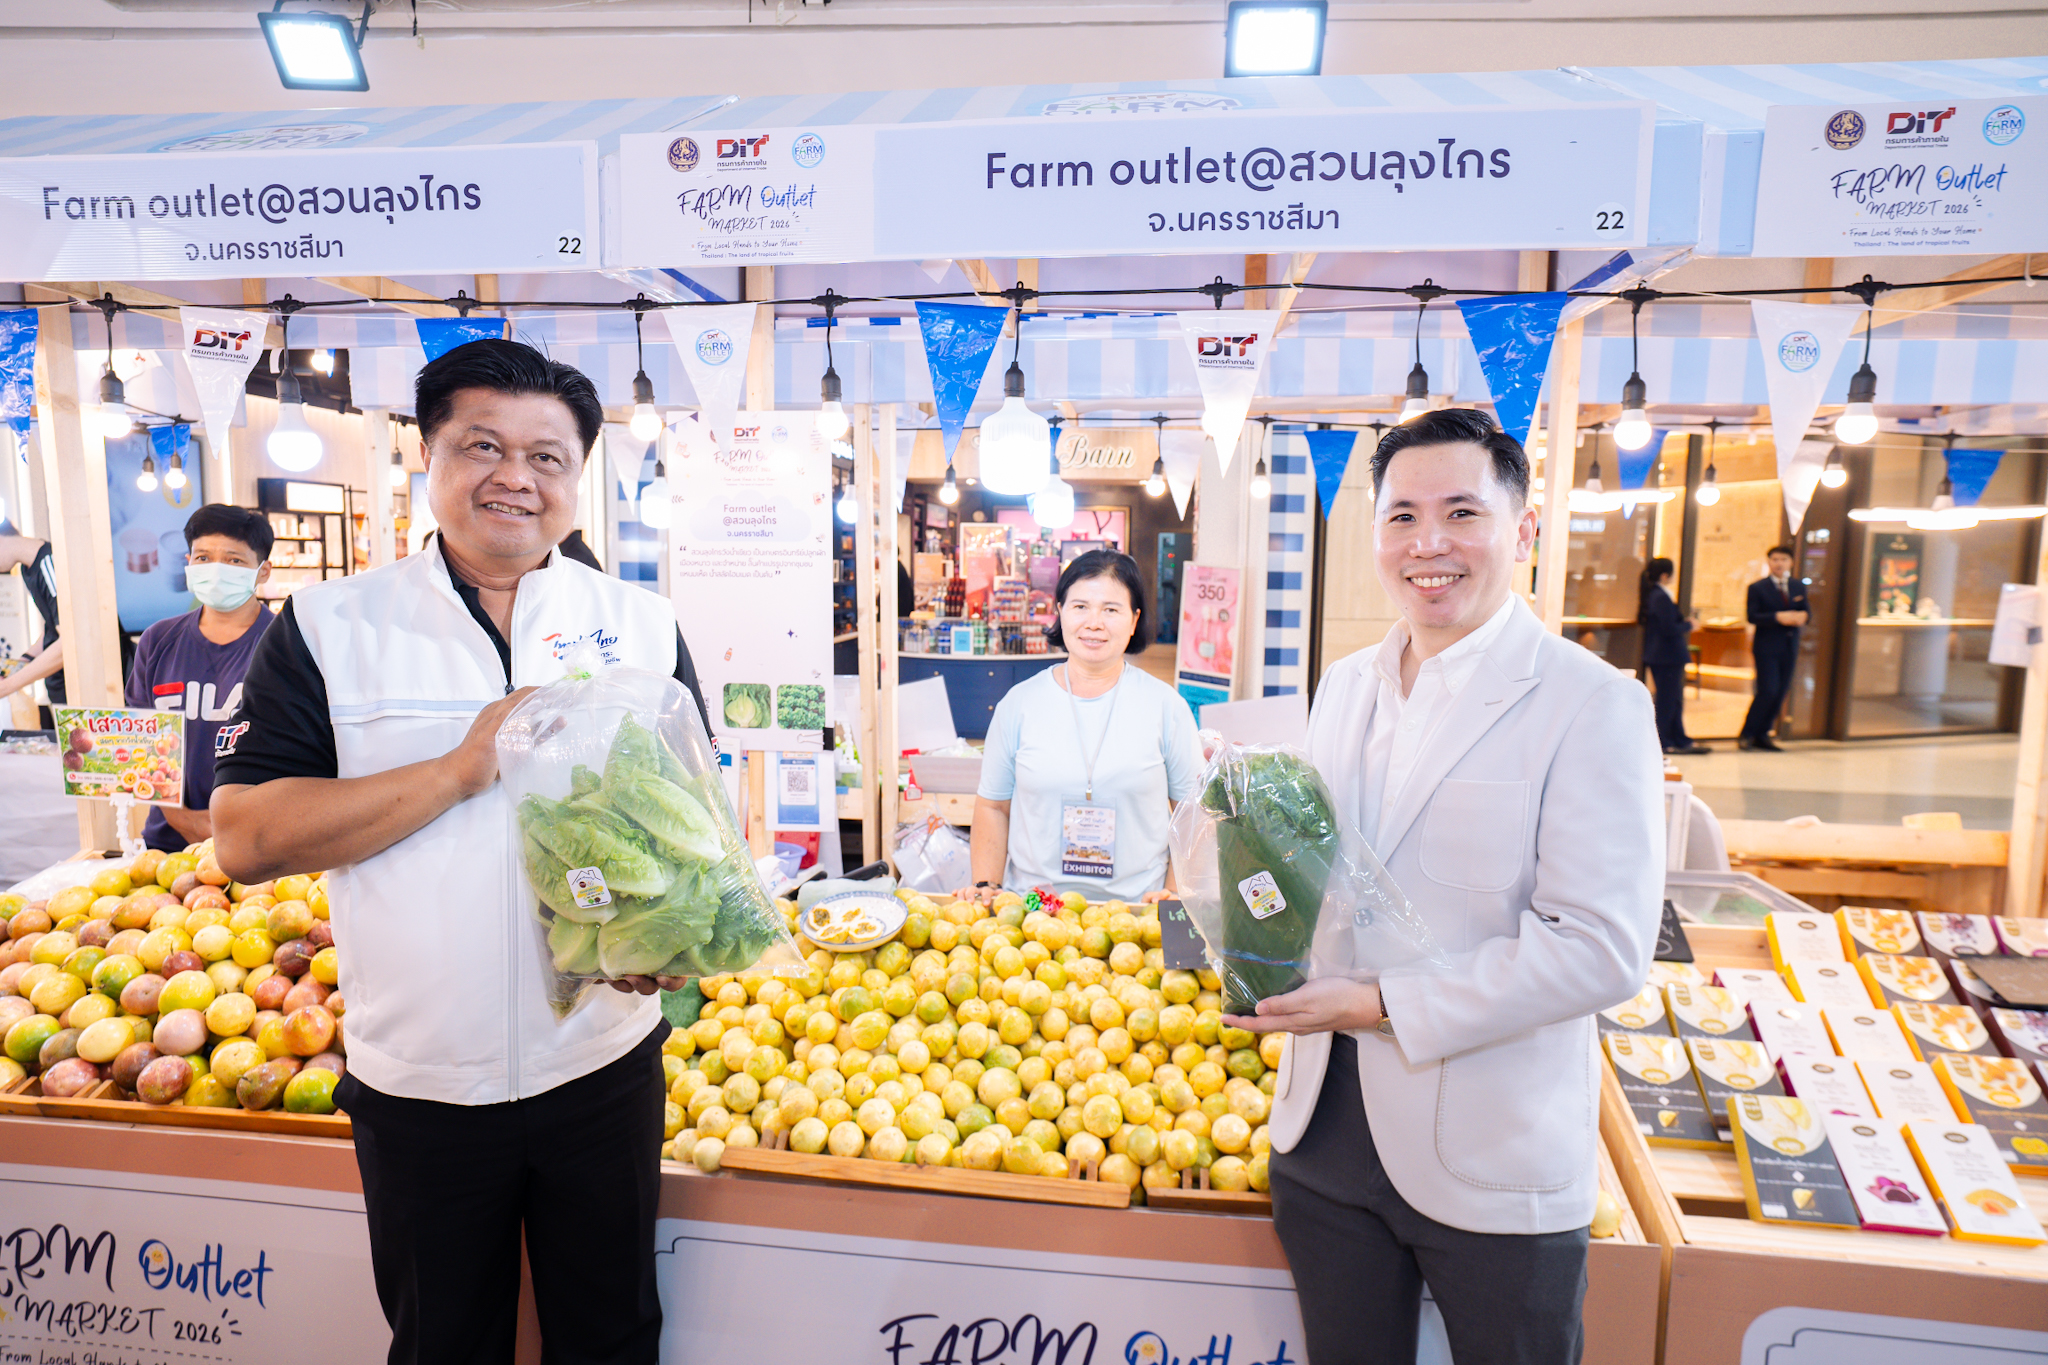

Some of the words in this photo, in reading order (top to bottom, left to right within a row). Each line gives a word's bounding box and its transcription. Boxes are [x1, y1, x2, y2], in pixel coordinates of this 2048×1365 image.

[1986, 119, 2022, 130] FARM
[1986, 128, 2020, 137] OUTLET
[1885, 135, 1949, 145] กรมการค้าภายใน
[794, 145, 823, 155] FARM
[717, 158, 767, 167] กรมการค้าภายใน
[986, 152, 1093, 189] Farm
[1109, 138, 1511, 193] outlet@สวนลุงไกร
[1830, 163, 1926, 204] FARM
[1936, 163, 2008, 192] Outlet
[43, 186, 136, 220] Farm
[149, 174, 481, 224] outlet@สวนลุงไกร
[677, 184, 752, 220] FARM
[760, 183, 817, 210] Outlet
[1866, 200, 1943, 220] MARKET
[1944, 204, 1969, 214] 2026
[1148, 202, 1340, 232] จ.นครราชสีมา
[1596, 211, 1625, 231] 22
[708, 215, 768, 234] MARKET
[770, 220, 790, 229] 2026
[1849, 227, 1868, 237] From
[1870, 226, 1891, 237] Local
[1894, 225, 1918, 236] Hands
[1921, 226, 1928, 236] to
[1931, 225, 1951, 236] Your
[1954, 224, 1976, 235] Home
[184, 234, 343, 261] จ.นครราชสีมา
[557, 237, 581, 255] 22
[697, 241, 712, 249] From
[714, 241, 731, 249] Local
[699, 342, 731, 351] FARM
[1781, 345, 1817, 356] FARM
[191, 348, 249, 360] กรมการค้าภายใน
[1781, 354, 1816, 362] OUTLET
[1198, 358, 1255, 366] กรมการค้าภายใน
[1061, 433, 1136, 469] Barn
[723, 504, 747, 513] Farm
[749, 504, 776, 513] outlet
[722, 515, 777, 527] @สวนลุงไกร
[726, 529, 774, 538] จ.นครราชสีมา
[1198, 584, 1226, 601] 350
[88, 716, 158, 735] เสาวรส
[1063, 864, 1113, 875] EXHIBITOR
[0, 1224, 116, 1297] RM
[139, 1239, 274, 1309] Outlet
[15, 1294, 166, 1340] MARKET
[174, 1320, 222, 1345] 2026
